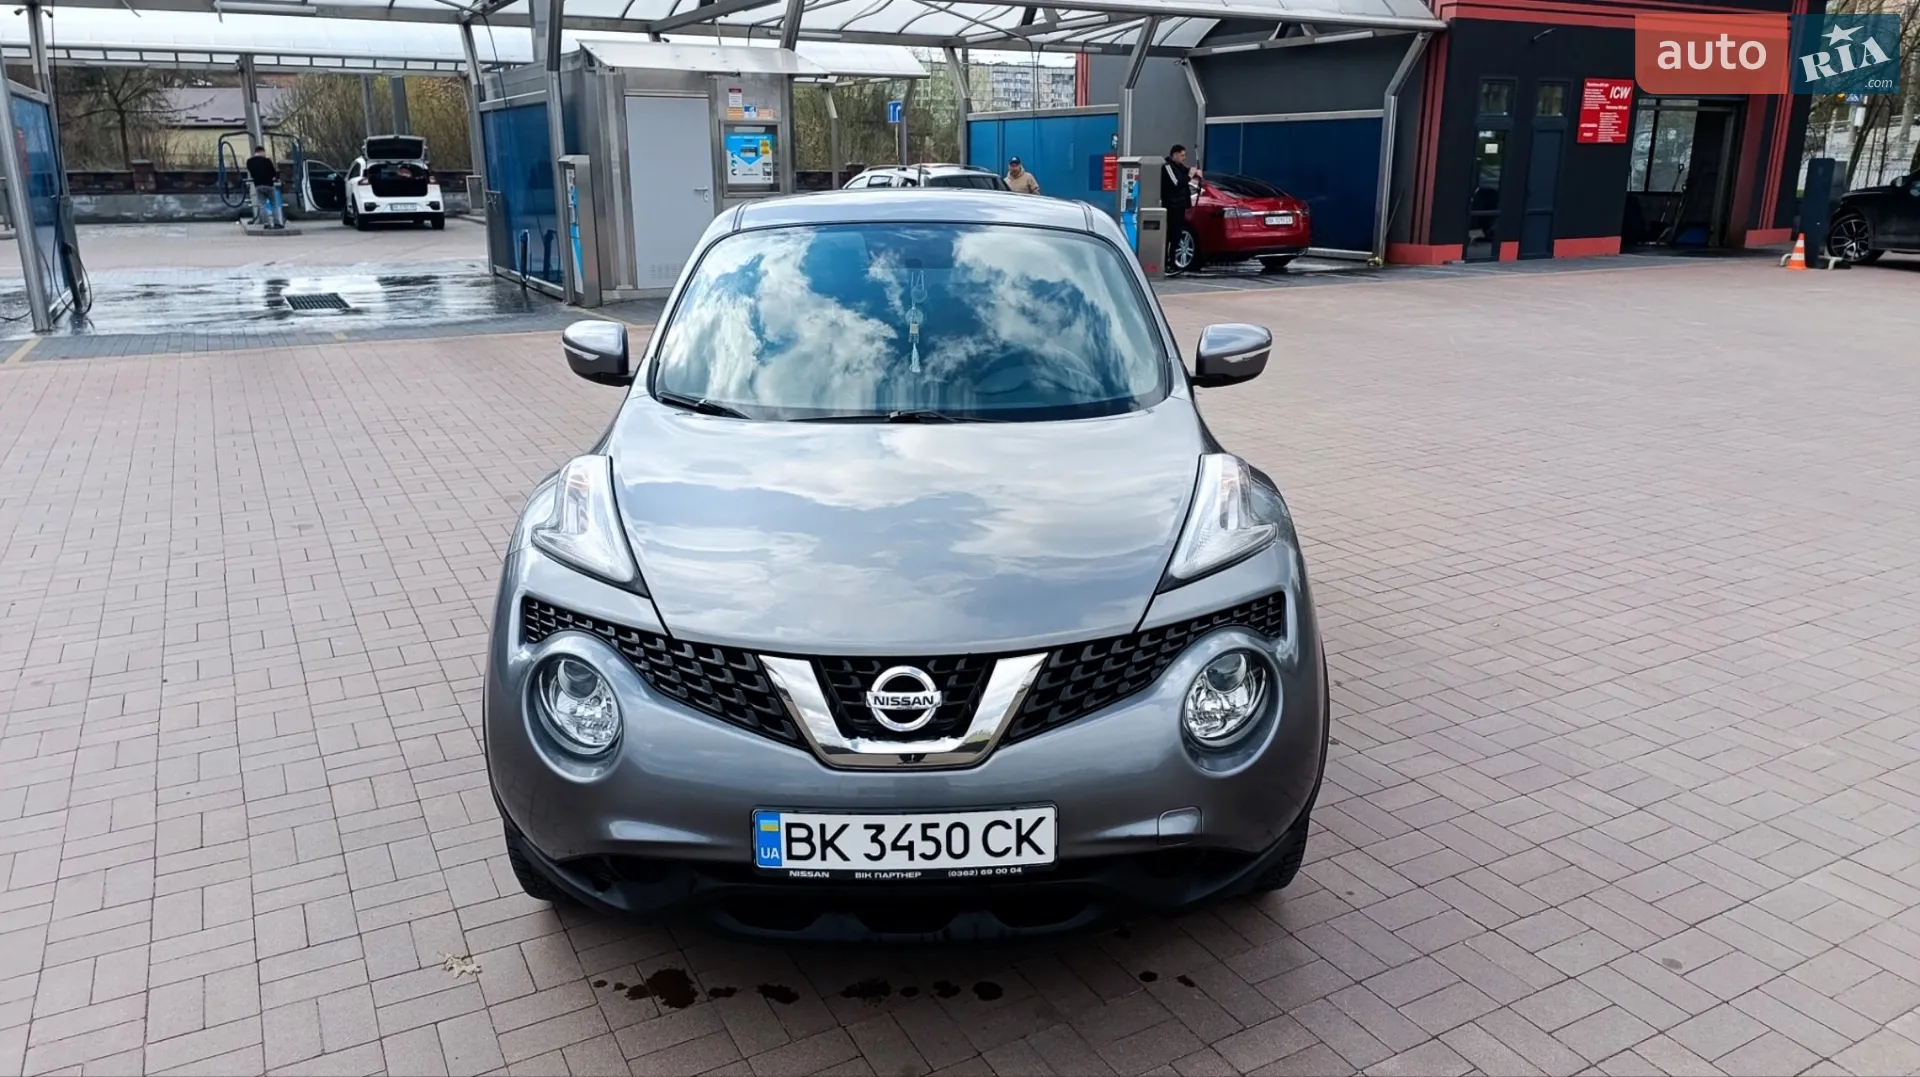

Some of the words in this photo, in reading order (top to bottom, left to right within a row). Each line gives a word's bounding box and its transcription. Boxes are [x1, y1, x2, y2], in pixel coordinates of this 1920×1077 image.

[1609, 86, 1631, 99] ICW
[873, 695, 934, 706] NISSAN
[785, 822, 851, 862] BK
[863, 822, 970, 862] 3450
[981, 816, 1047, 858] CK
[760, 847, 780, 860] UA
[789, 870, 830, 878] NISSAN
[995, 867, 1008, 875] 00
